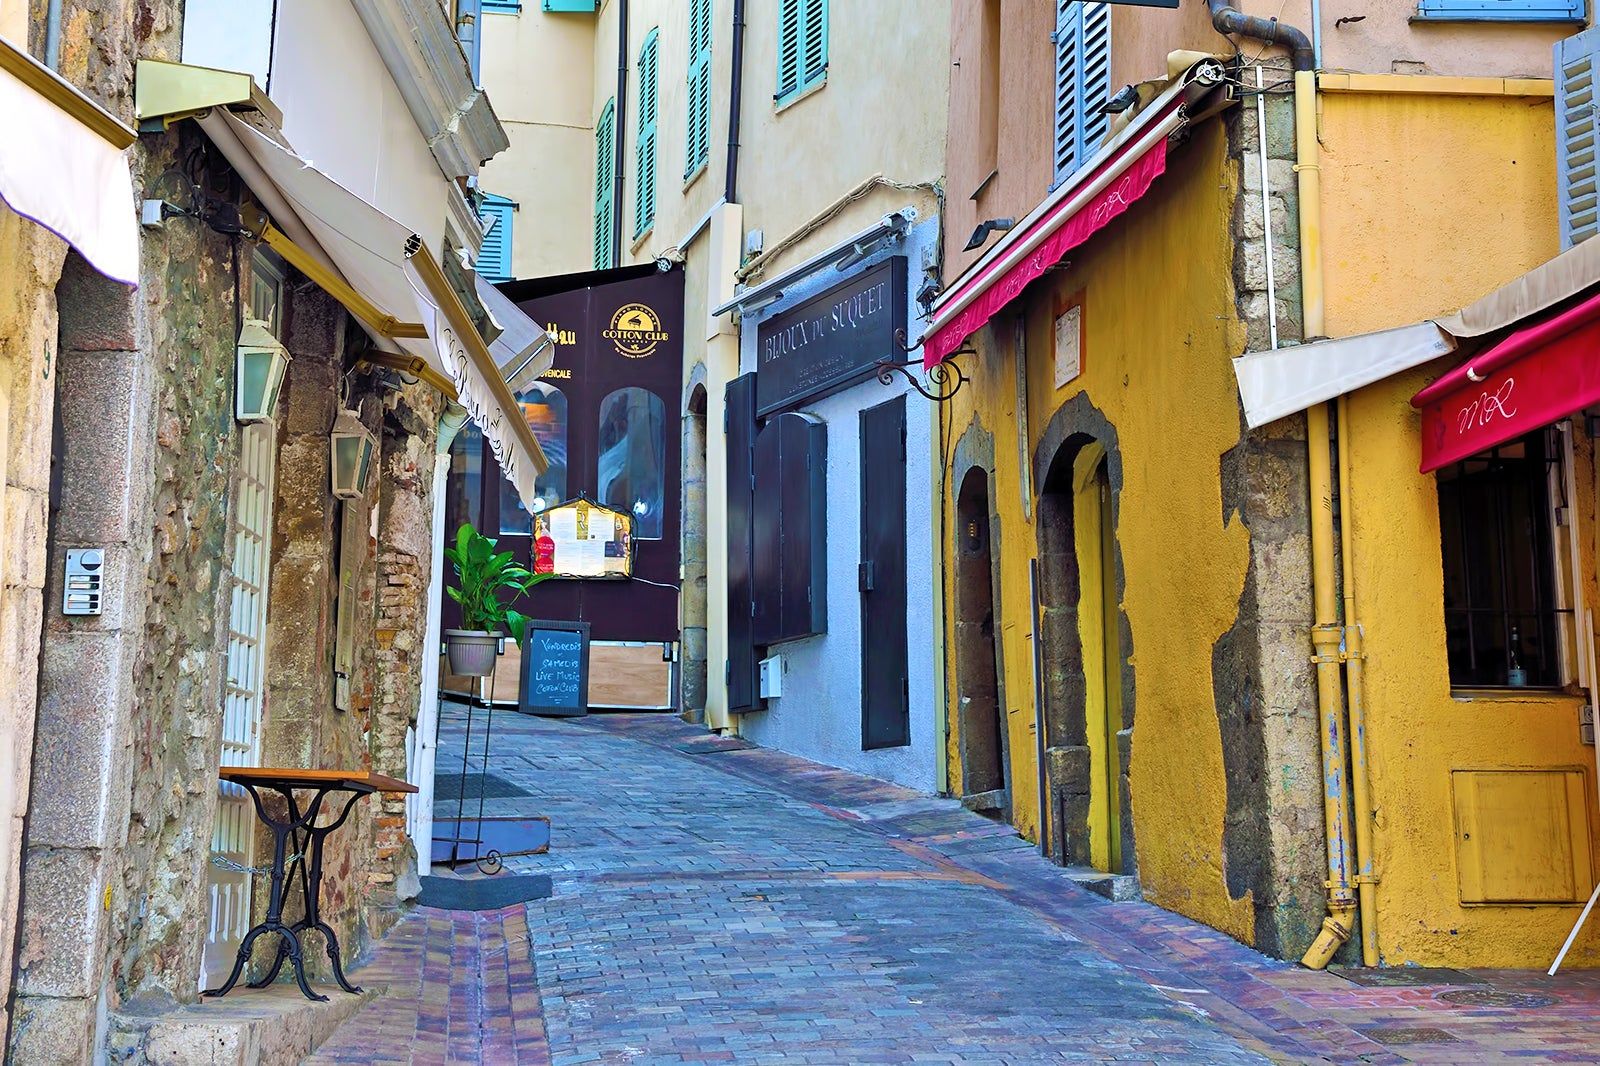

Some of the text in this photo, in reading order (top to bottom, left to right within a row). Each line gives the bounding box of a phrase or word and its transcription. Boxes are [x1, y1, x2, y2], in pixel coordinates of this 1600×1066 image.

[602, 329, 669, 341] COTTON CLUB
[765, 319, 808, 363] BIJOUX
[831, 282, 885, 331] SUQUET
[1457, 377, 1518, 434] MR
